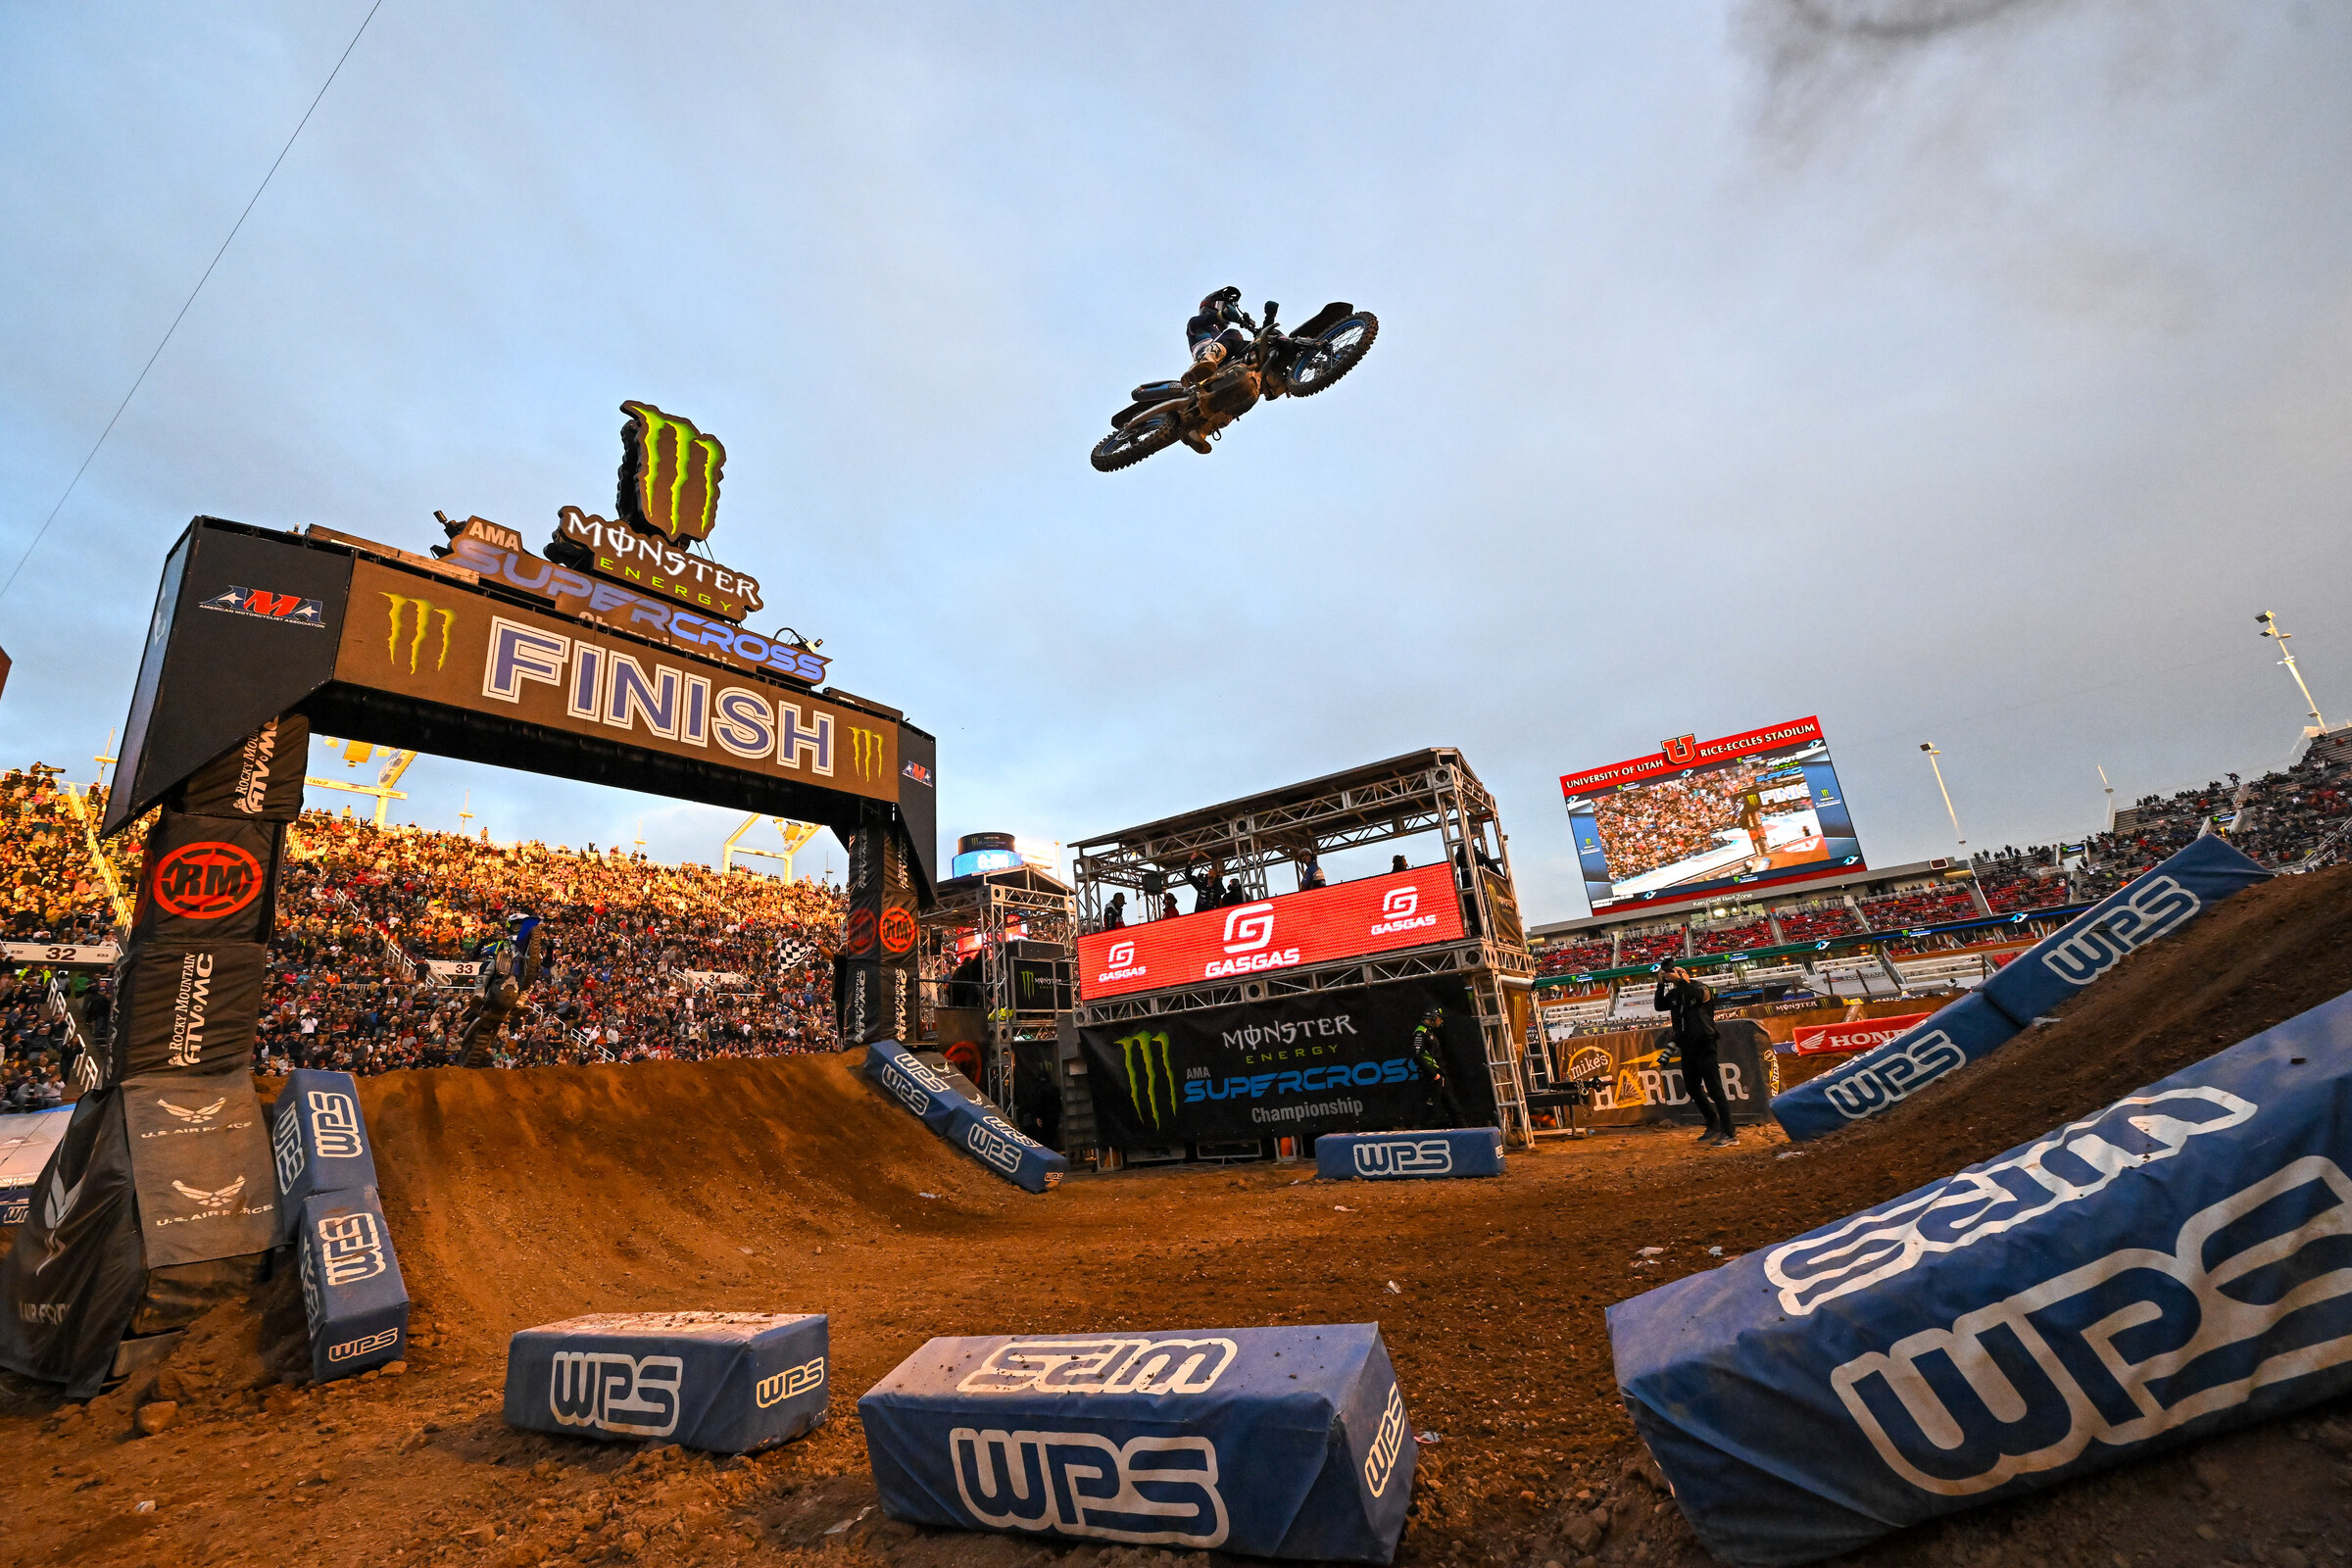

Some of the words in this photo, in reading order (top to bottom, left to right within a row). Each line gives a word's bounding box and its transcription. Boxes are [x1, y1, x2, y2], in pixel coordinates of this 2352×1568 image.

[468, 521, 519, 552] AMA
[568, 513, 759, 606] MONSTER
[600, 557, 732, 612] ENERGY
[199, 585, 326, 625] AMA
[199, 604, 234, 613] AMERICAN
[235, 610, 283, 620] MOTORCYCLIST
[284, 618, 325, 628] ASSOCIATION
[448, 538, 826, 681] SUPERCROSS
[482, 614, 835, 778] FINISH
[1661, 733, 1695, 764] U
[1700, 736, 1763, 758] RICE-ECCLES
[1765, 723, 1815, 742] STADIUM
[235, 760, 253, 796] ROCKY
[903, 760, 933, 786] AMA
[1566, 769, 1619, 789] UNIVERSITY
[1621, 766, 1635, 776] OF
[1637, 760, 1664, 772] UTAH
[173, 863, 243, 896] RM
[1371, 914, 1436, 935] GASGAS
[2041, 875, 2201, 985] WPS
[46, 948, 76, 961] 32
[455, 964, 473, 974] 33
[1205, 948, 1299, 978] GASGAS
[174, 953, 196, 1013] MOUNTAIN
[709, 974, 721, 983] 34
[1099, 966, 1147, 982] GASGAS
[1776, 1001, 1818, 1011] MONSTER
[169, 1014, 187, 1051] ROCKY
[1222, 1014, 1358, 1052] MONSTER
[1829, 1029, 1907, 1049] HON
[1247, 1045, 1338, 1064] ENERGY
[1571, 1054, 1609, 1080] mike's
[882, 1063, 930, 1116] WPS
[894, 1053, 951, 1093] WPS
[1186, 1066, 1210, 1080] AMA
[1590, 1062, 1749, 1111] HARDR
[1824, 1029, 1966, 1119] WPS
[203, 1121, 252, 1132] FCE
[308, 1091, 363, 1157] WPS
[1251, 1097, 1363, 1123] Championship
[967, 1122, 1022, 1173] WPS
[1353, 1140, 1452, 1176] WPS
[1045, 1172, 1063, 1181] WPS
[191, 1210, 219, 1221] AIR
[222, 1203, 273, 1216] FRCE
[318, 1212, 386, 1286] WPS
[1831, 1154, 2352, 1496] WPS
[329, 1327, 398, 1362] WPS
[757, 1356, 824, 1408] WPS
[956, 1338, 1238, 1395] WPS
[550, 1351, 682, 1437] WPS
[1365, 1382, 1405, 1497] WPS
[950, 1427, 1229, 1548] WPS
